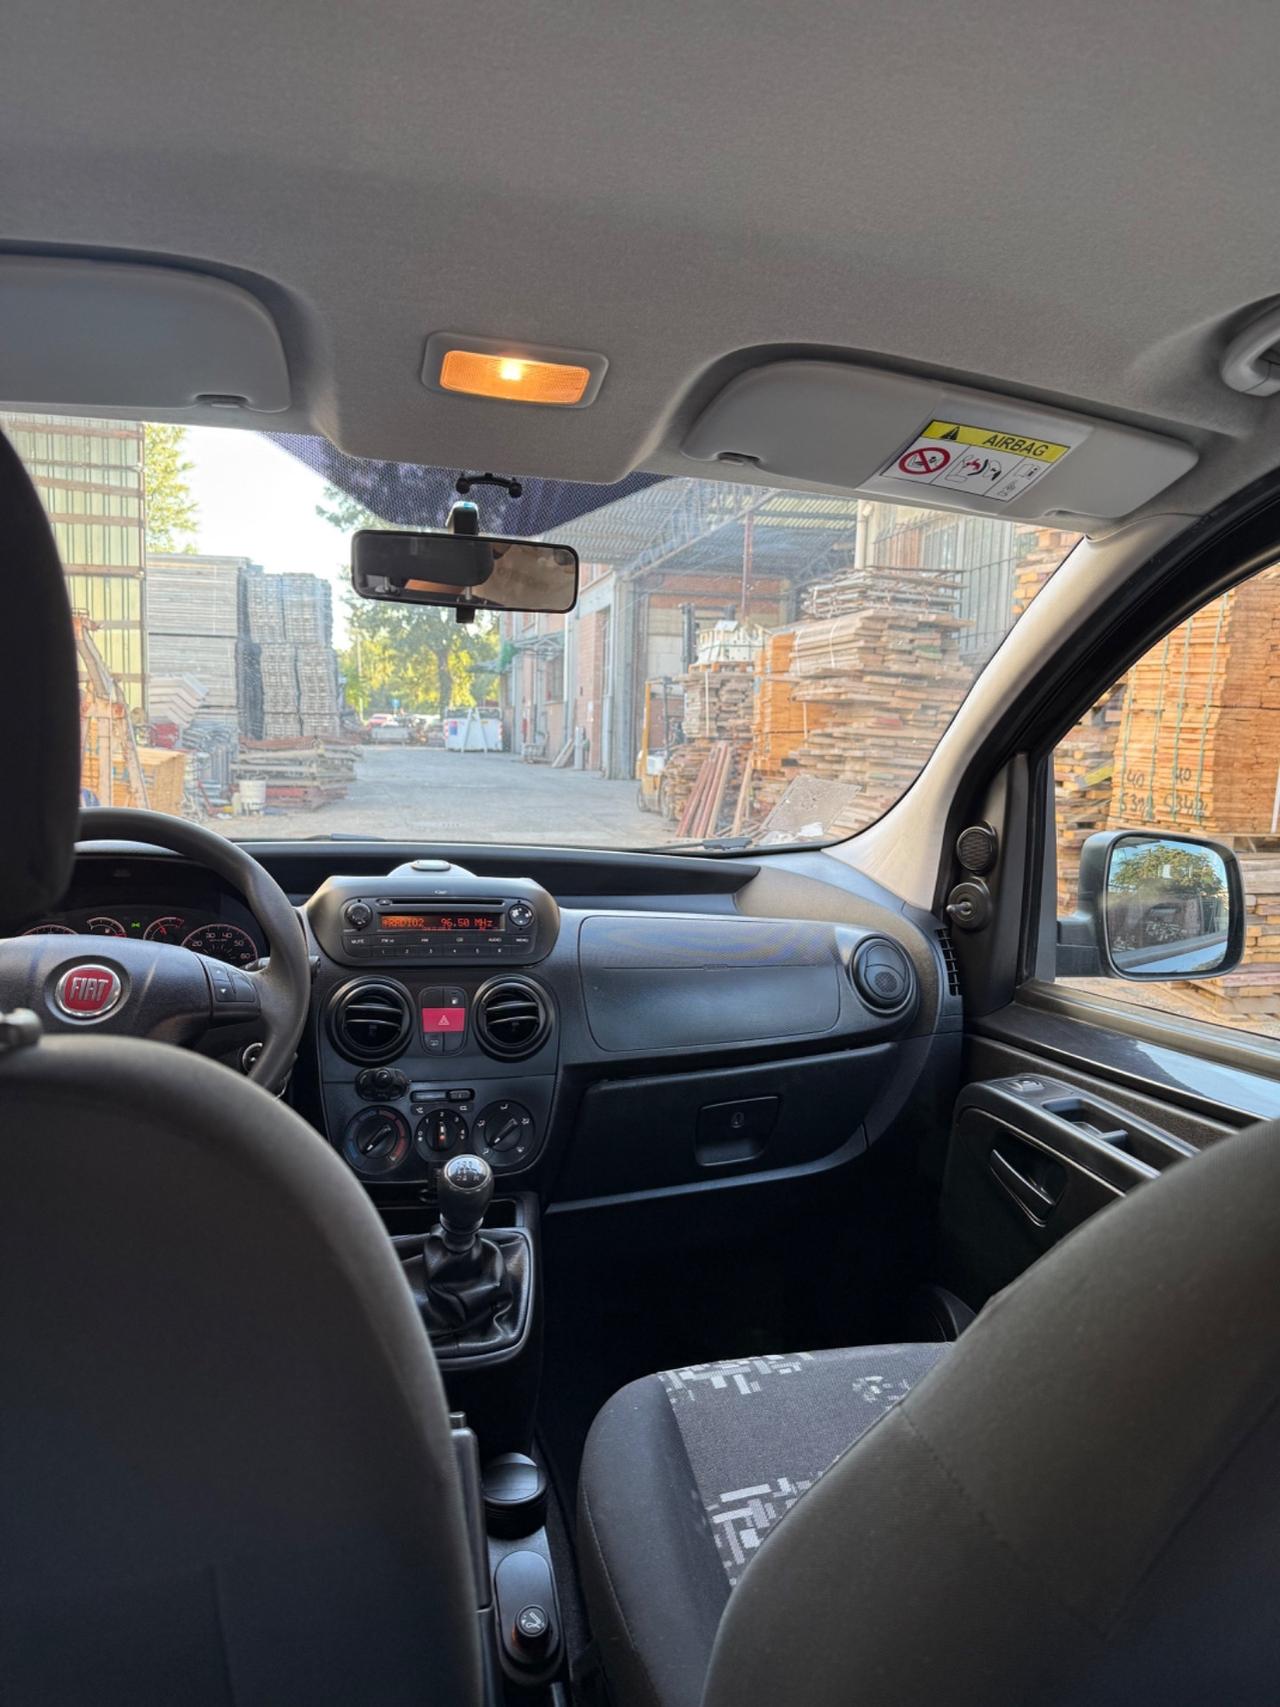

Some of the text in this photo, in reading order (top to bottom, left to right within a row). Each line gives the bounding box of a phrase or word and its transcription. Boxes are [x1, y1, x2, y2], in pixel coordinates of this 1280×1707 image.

[982, 434, 1049, 457] AIRBAG
[440, 918, 470, 929] 96.50
[474, 918, 493, 929] MHz
[69, 976, 109, 1001] FIAT
